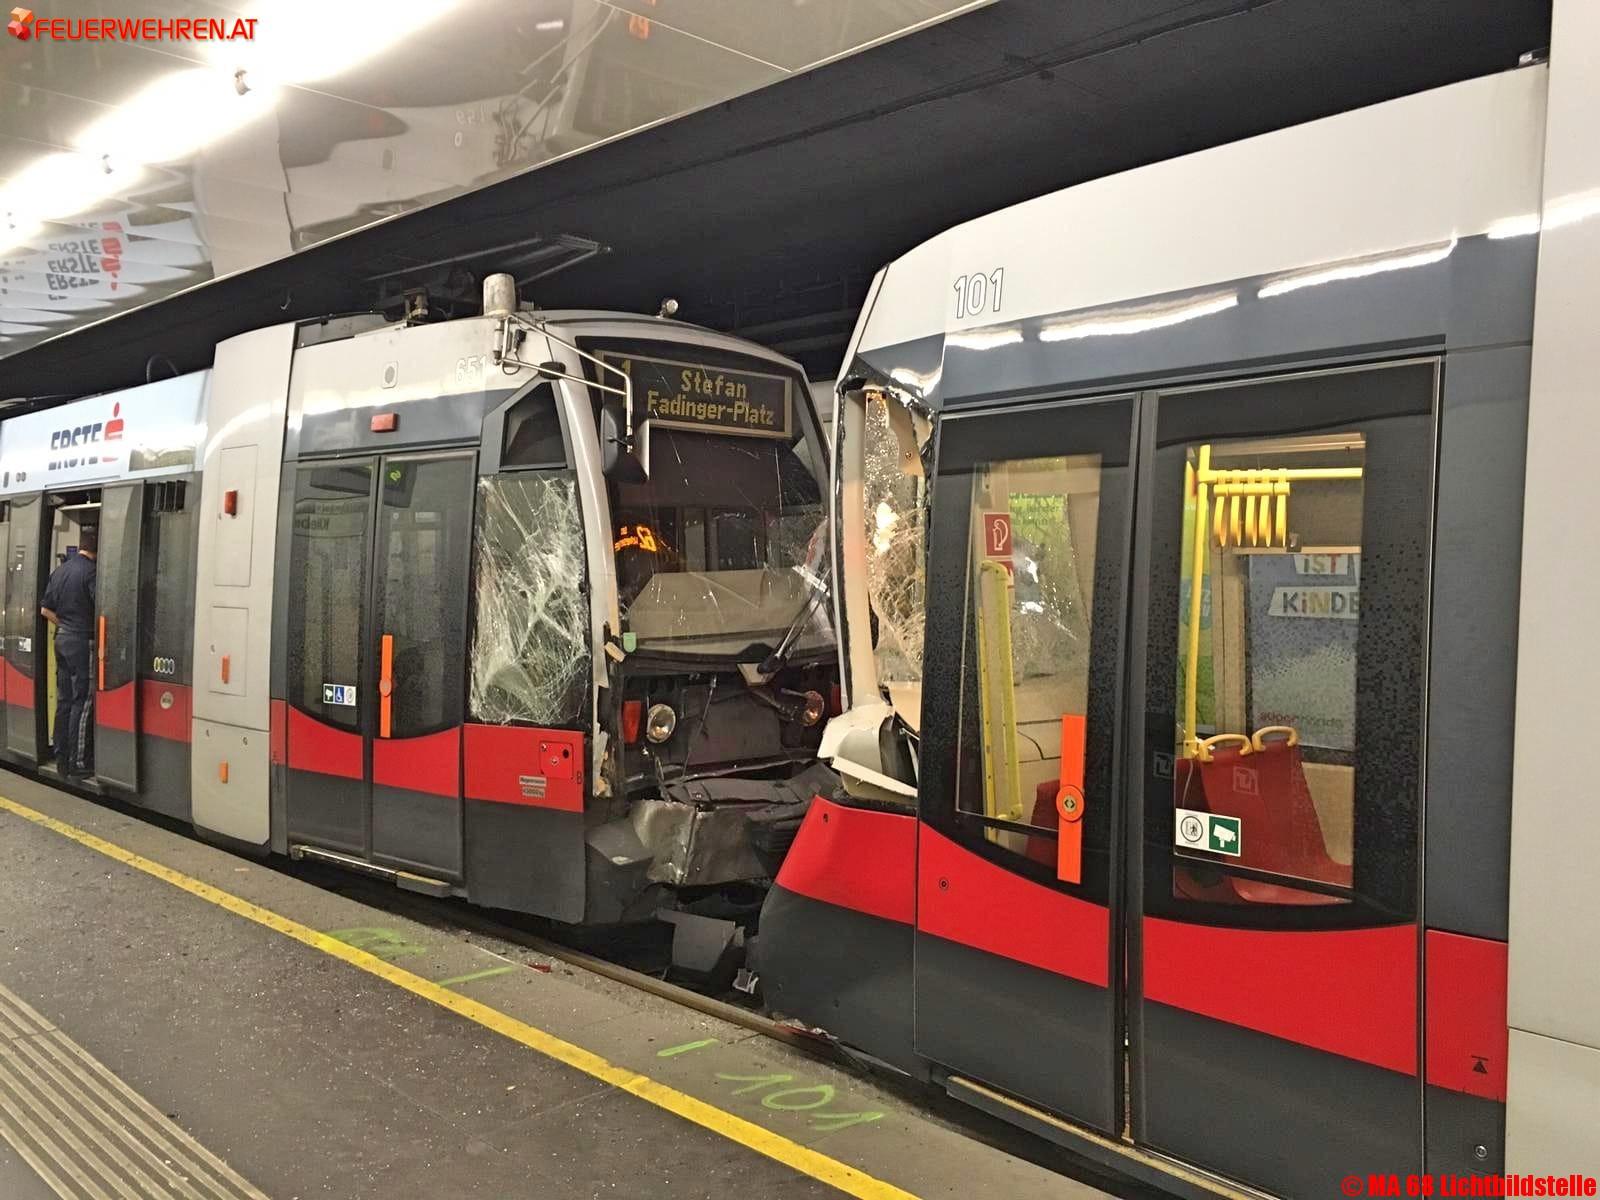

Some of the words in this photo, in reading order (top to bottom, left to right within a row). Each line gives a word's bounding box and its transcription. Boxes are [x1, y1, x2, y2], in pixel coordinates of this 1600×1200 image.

[953, 266, 1004, 319] 101
[455, 354, 487, 386] 651
[681, 369, 747, 399] Stefan
[647, 390, 774, 425] Fadinger-Platz
[714, 1072, 886, 1133] 101
